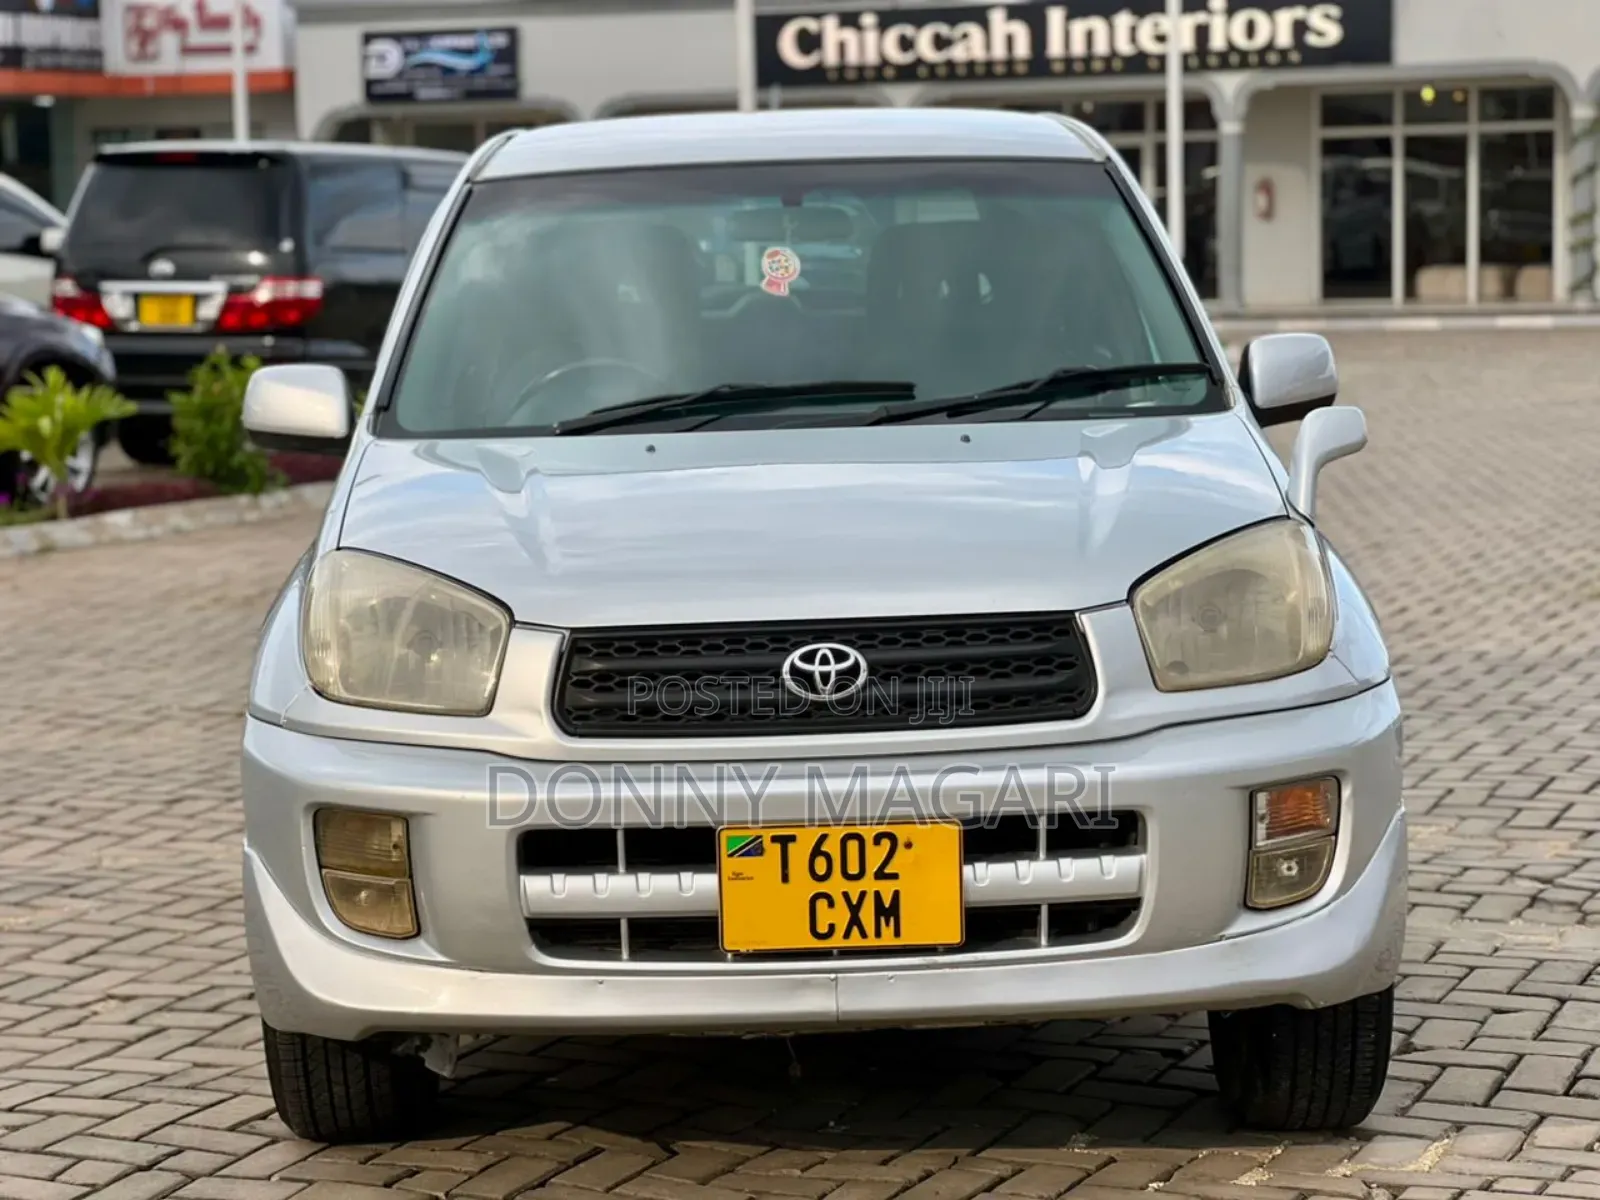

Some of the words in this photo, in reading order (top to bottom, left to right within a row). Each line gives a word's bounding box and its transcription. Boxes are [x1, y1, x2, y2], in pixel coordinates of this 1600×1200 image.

[776, 6, 1032, 70] Chiccah
[1045, 0, 1344, 60] Interiors
[770, 834, 796, 884] T
[808, 831, 900, 883] 602
[808, 888, 901, 940] CXM
